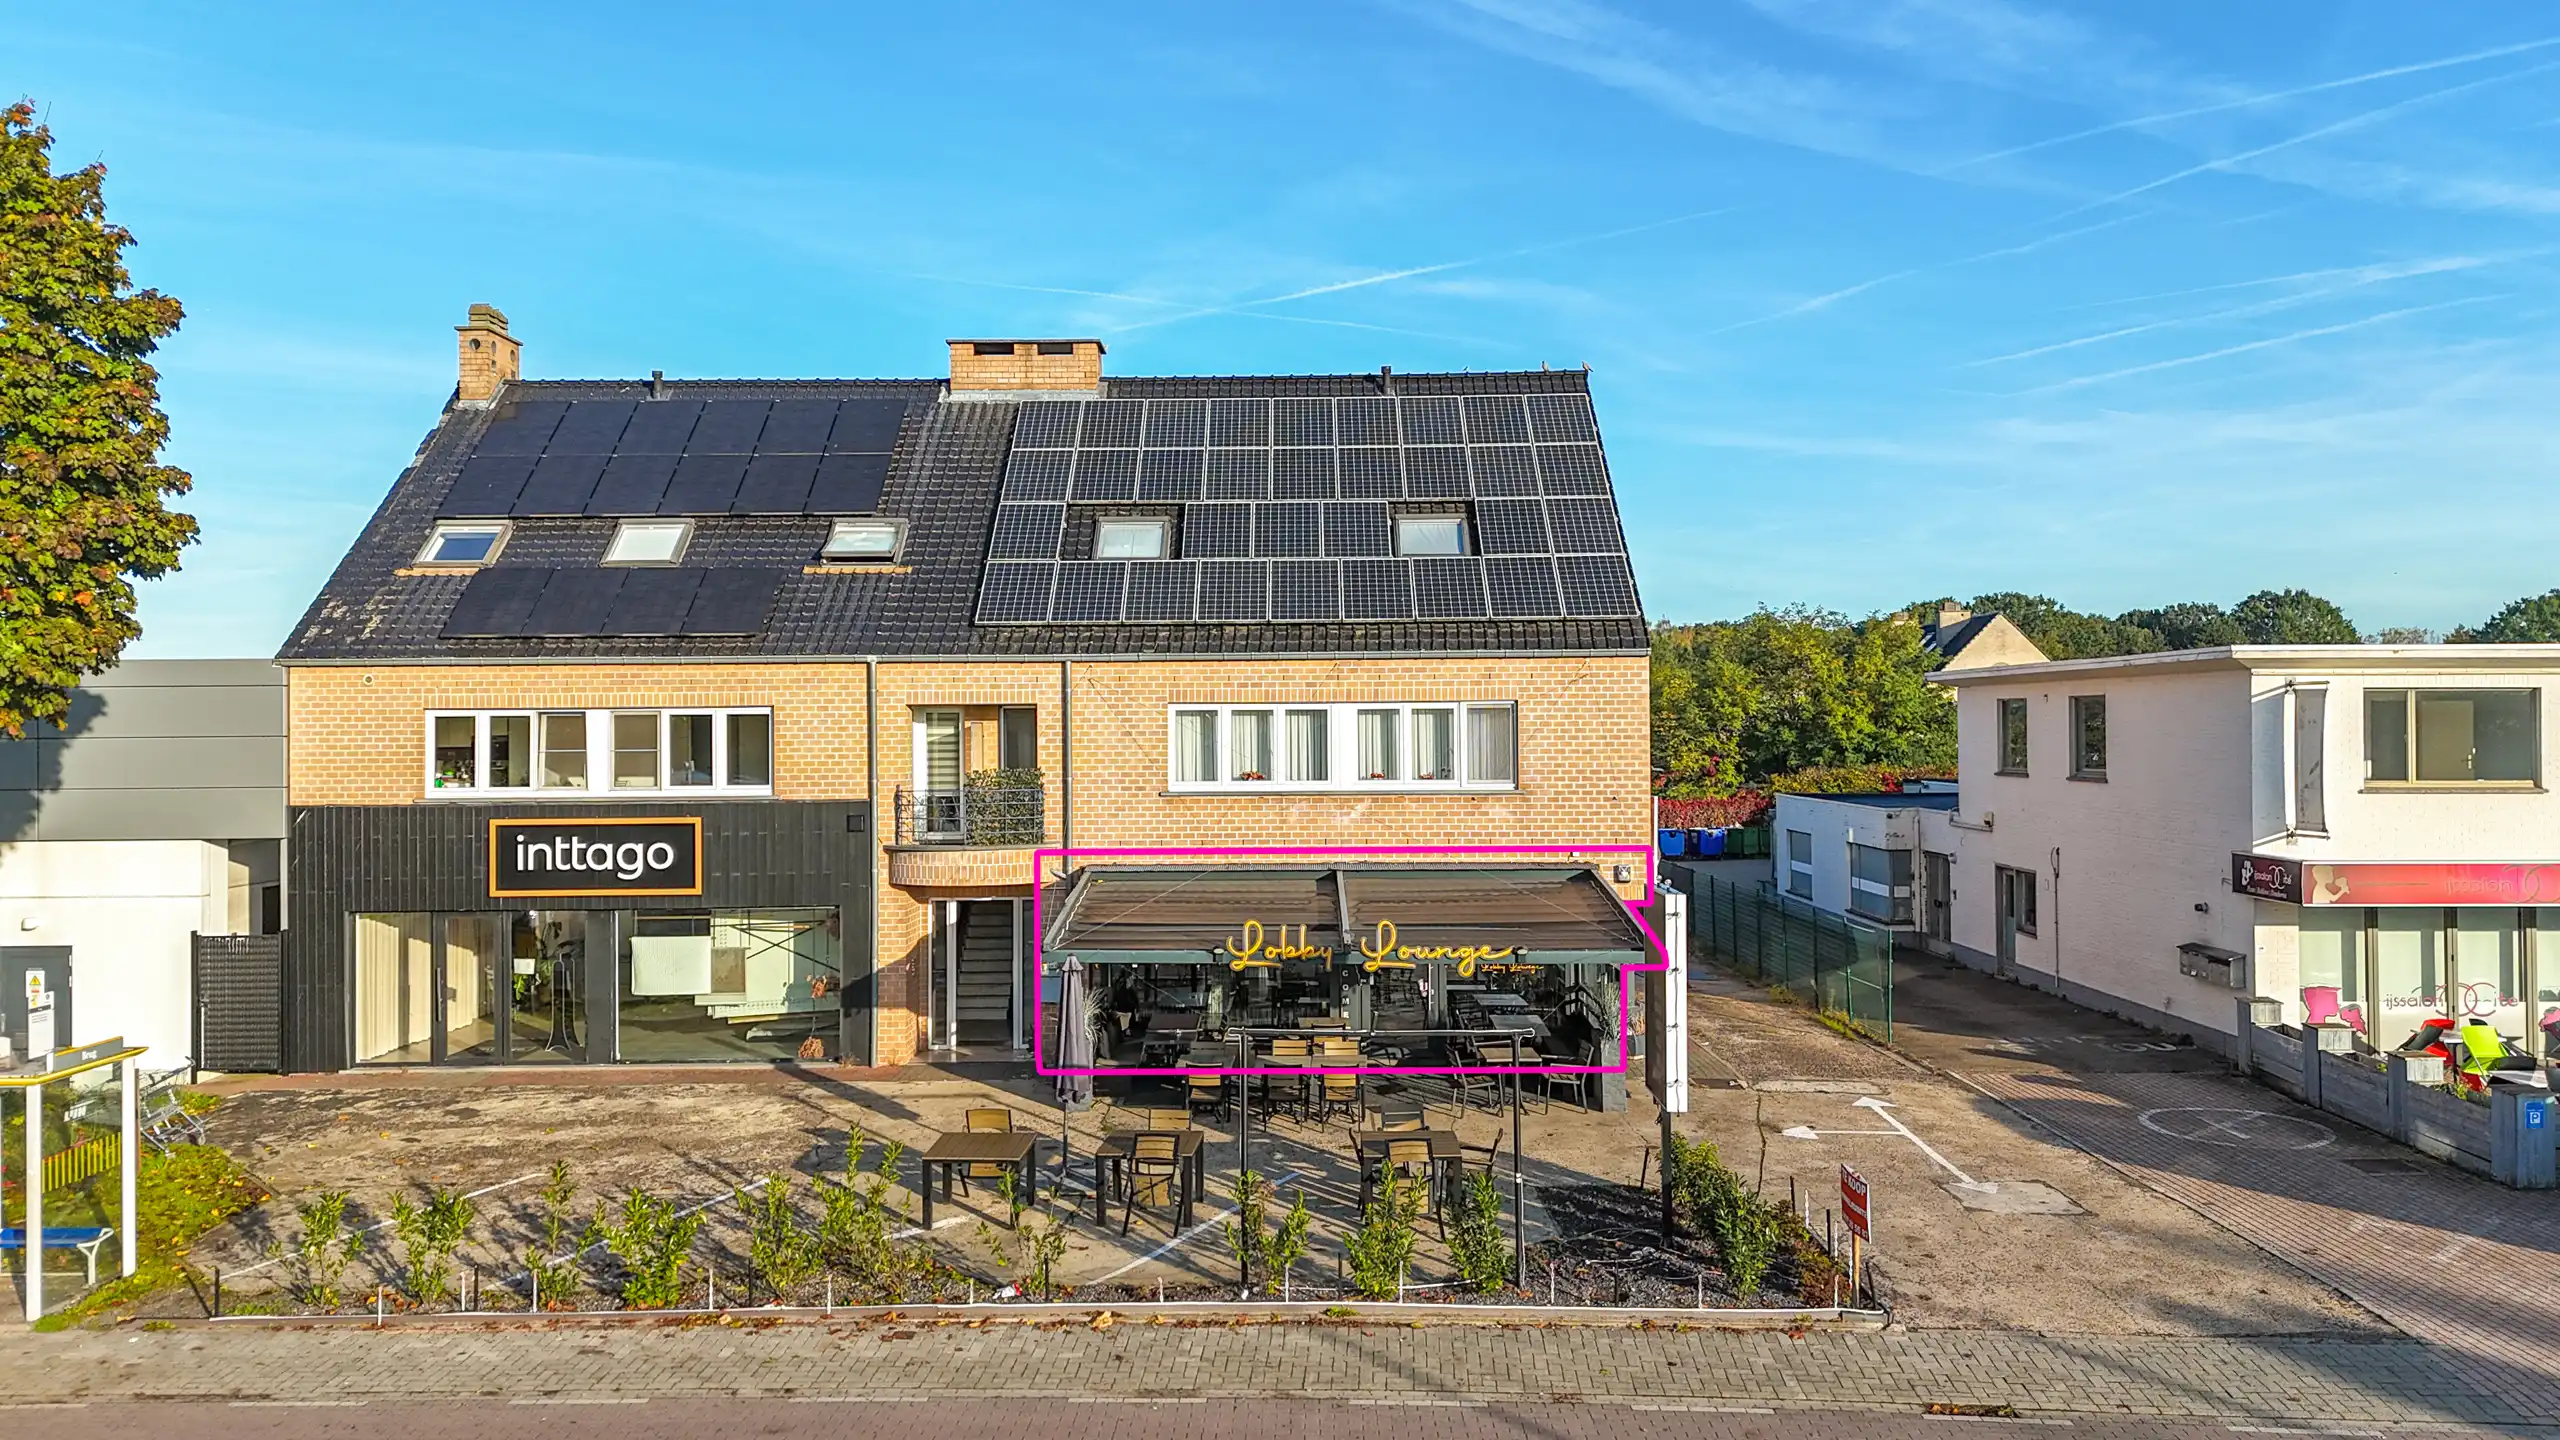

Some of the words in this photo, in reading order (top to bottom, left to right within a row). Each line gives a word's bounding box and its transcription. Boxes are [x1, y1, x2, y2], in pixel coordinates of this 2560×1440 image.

[516, 834, 674, 880] inttago
[1226, 919, 1332, 972] Lobby
[1359, 919, 1516, 977] Lounge
